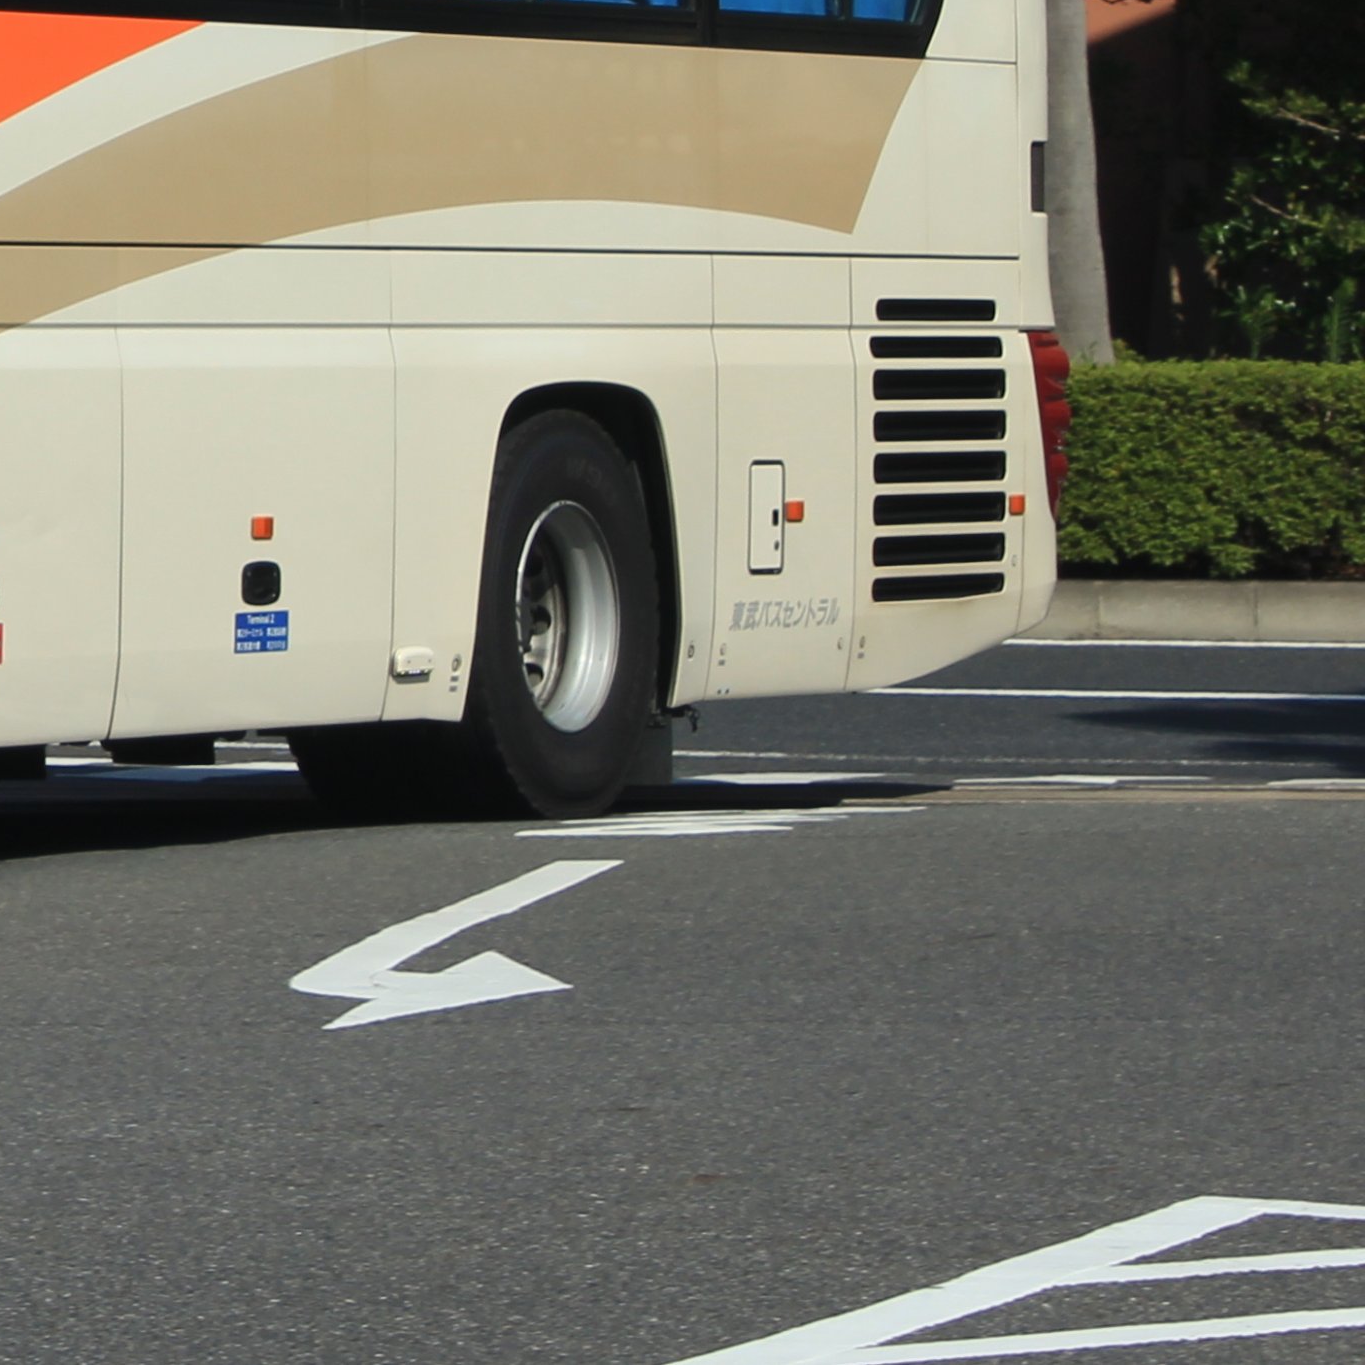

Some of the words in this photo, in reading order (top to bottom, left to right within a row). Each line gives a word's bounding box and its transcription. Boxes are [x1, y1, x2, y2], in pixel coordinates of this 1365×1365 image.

[729, 597, 840, 631] 東武バスセントラル
